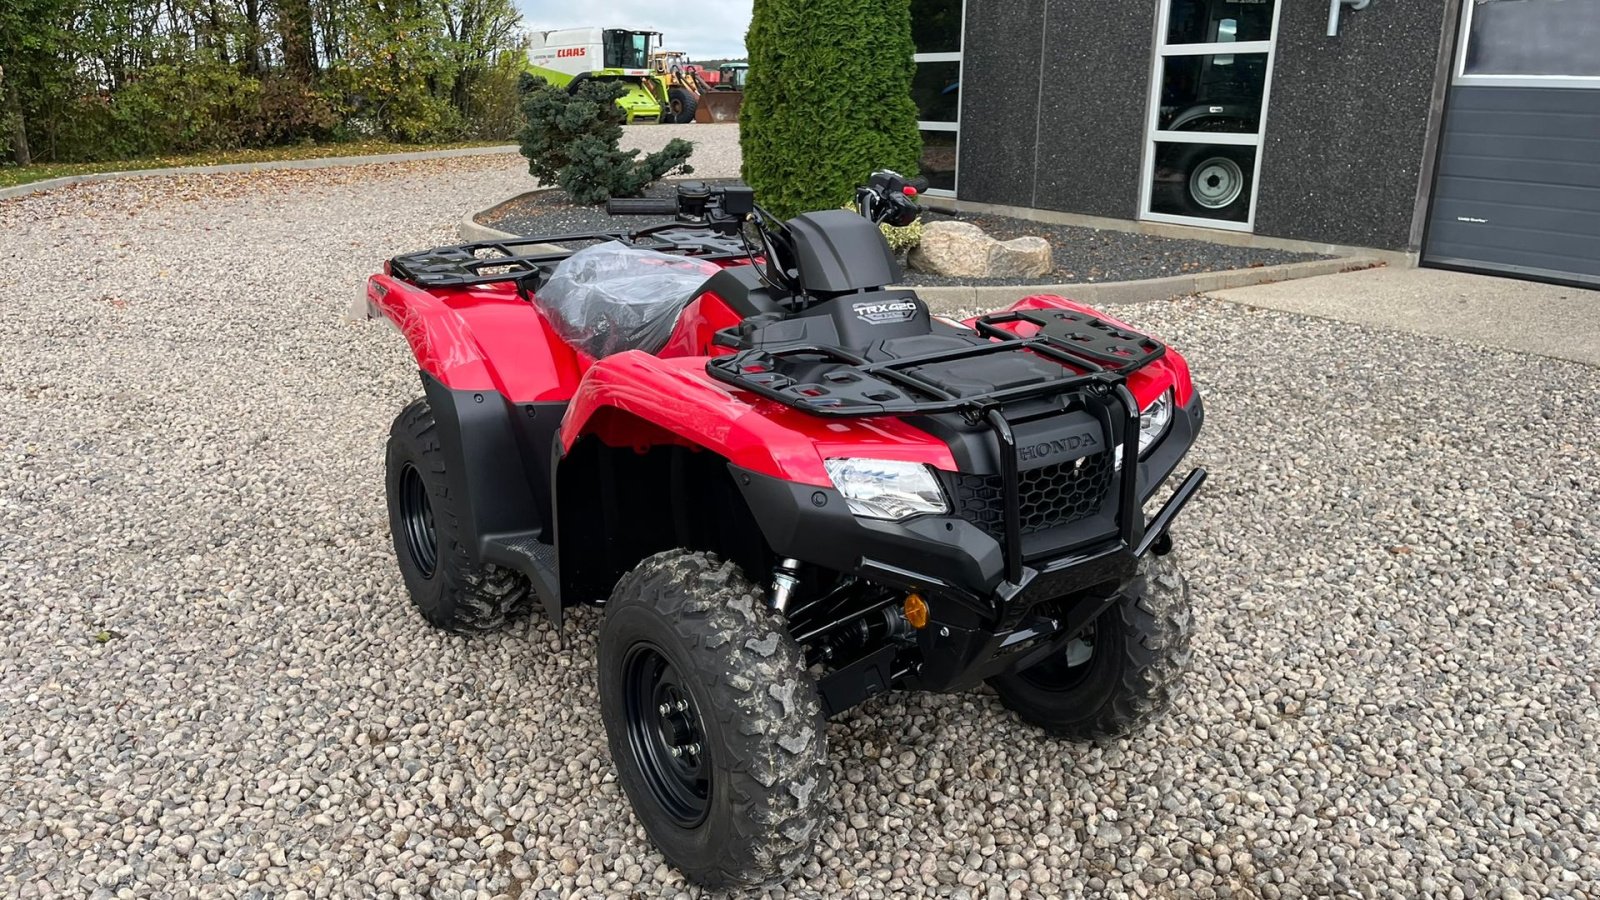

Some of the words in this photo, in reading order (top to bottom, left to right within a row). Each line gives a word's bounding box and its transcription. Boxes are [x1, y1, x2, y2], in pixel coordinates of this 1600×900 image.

[557, 47, 586, 58] CLAAS
[853, 302, 917, 316] TRX420
[1017, 432, 1098, 461] HONDA
